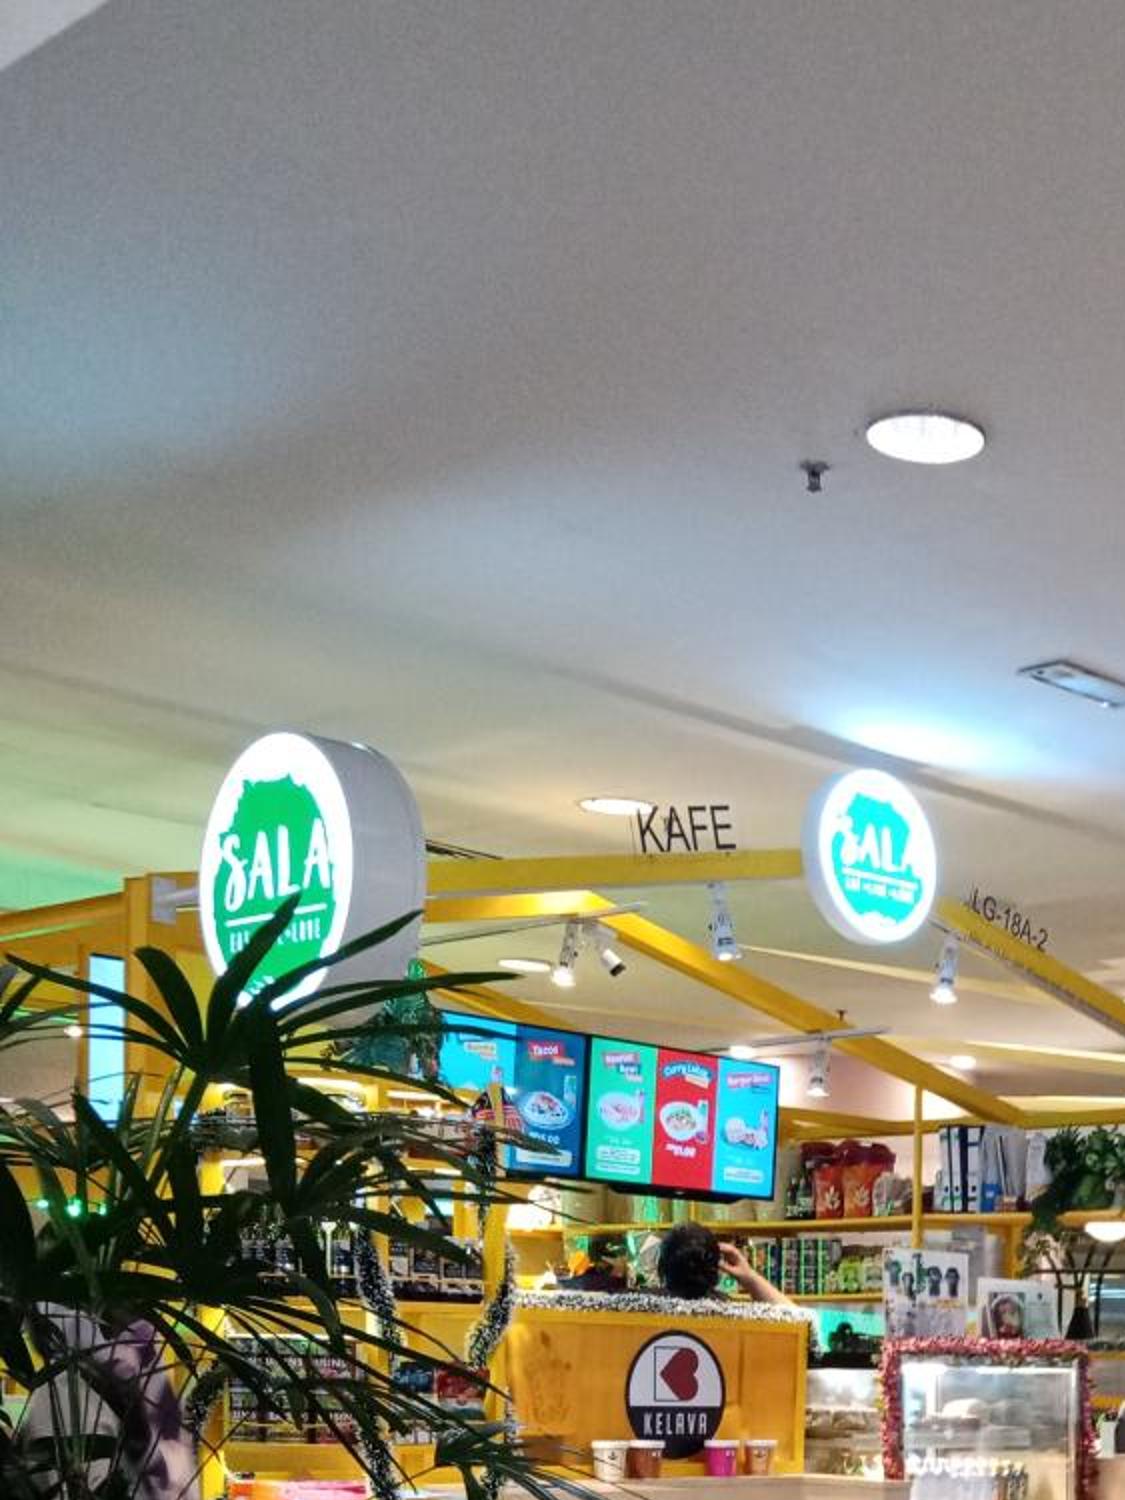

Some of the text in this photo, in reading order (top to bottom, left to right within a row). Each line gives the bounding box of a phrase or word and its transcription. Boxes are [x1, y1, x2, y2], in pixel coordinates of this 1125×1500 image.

[637, 805, 736, 853] KAFE
[222, 817, 331, 913] SALA
[971, 888, 1048, 953] LG-18A-2
[643, 1412, 707, 1436] KELAVA
